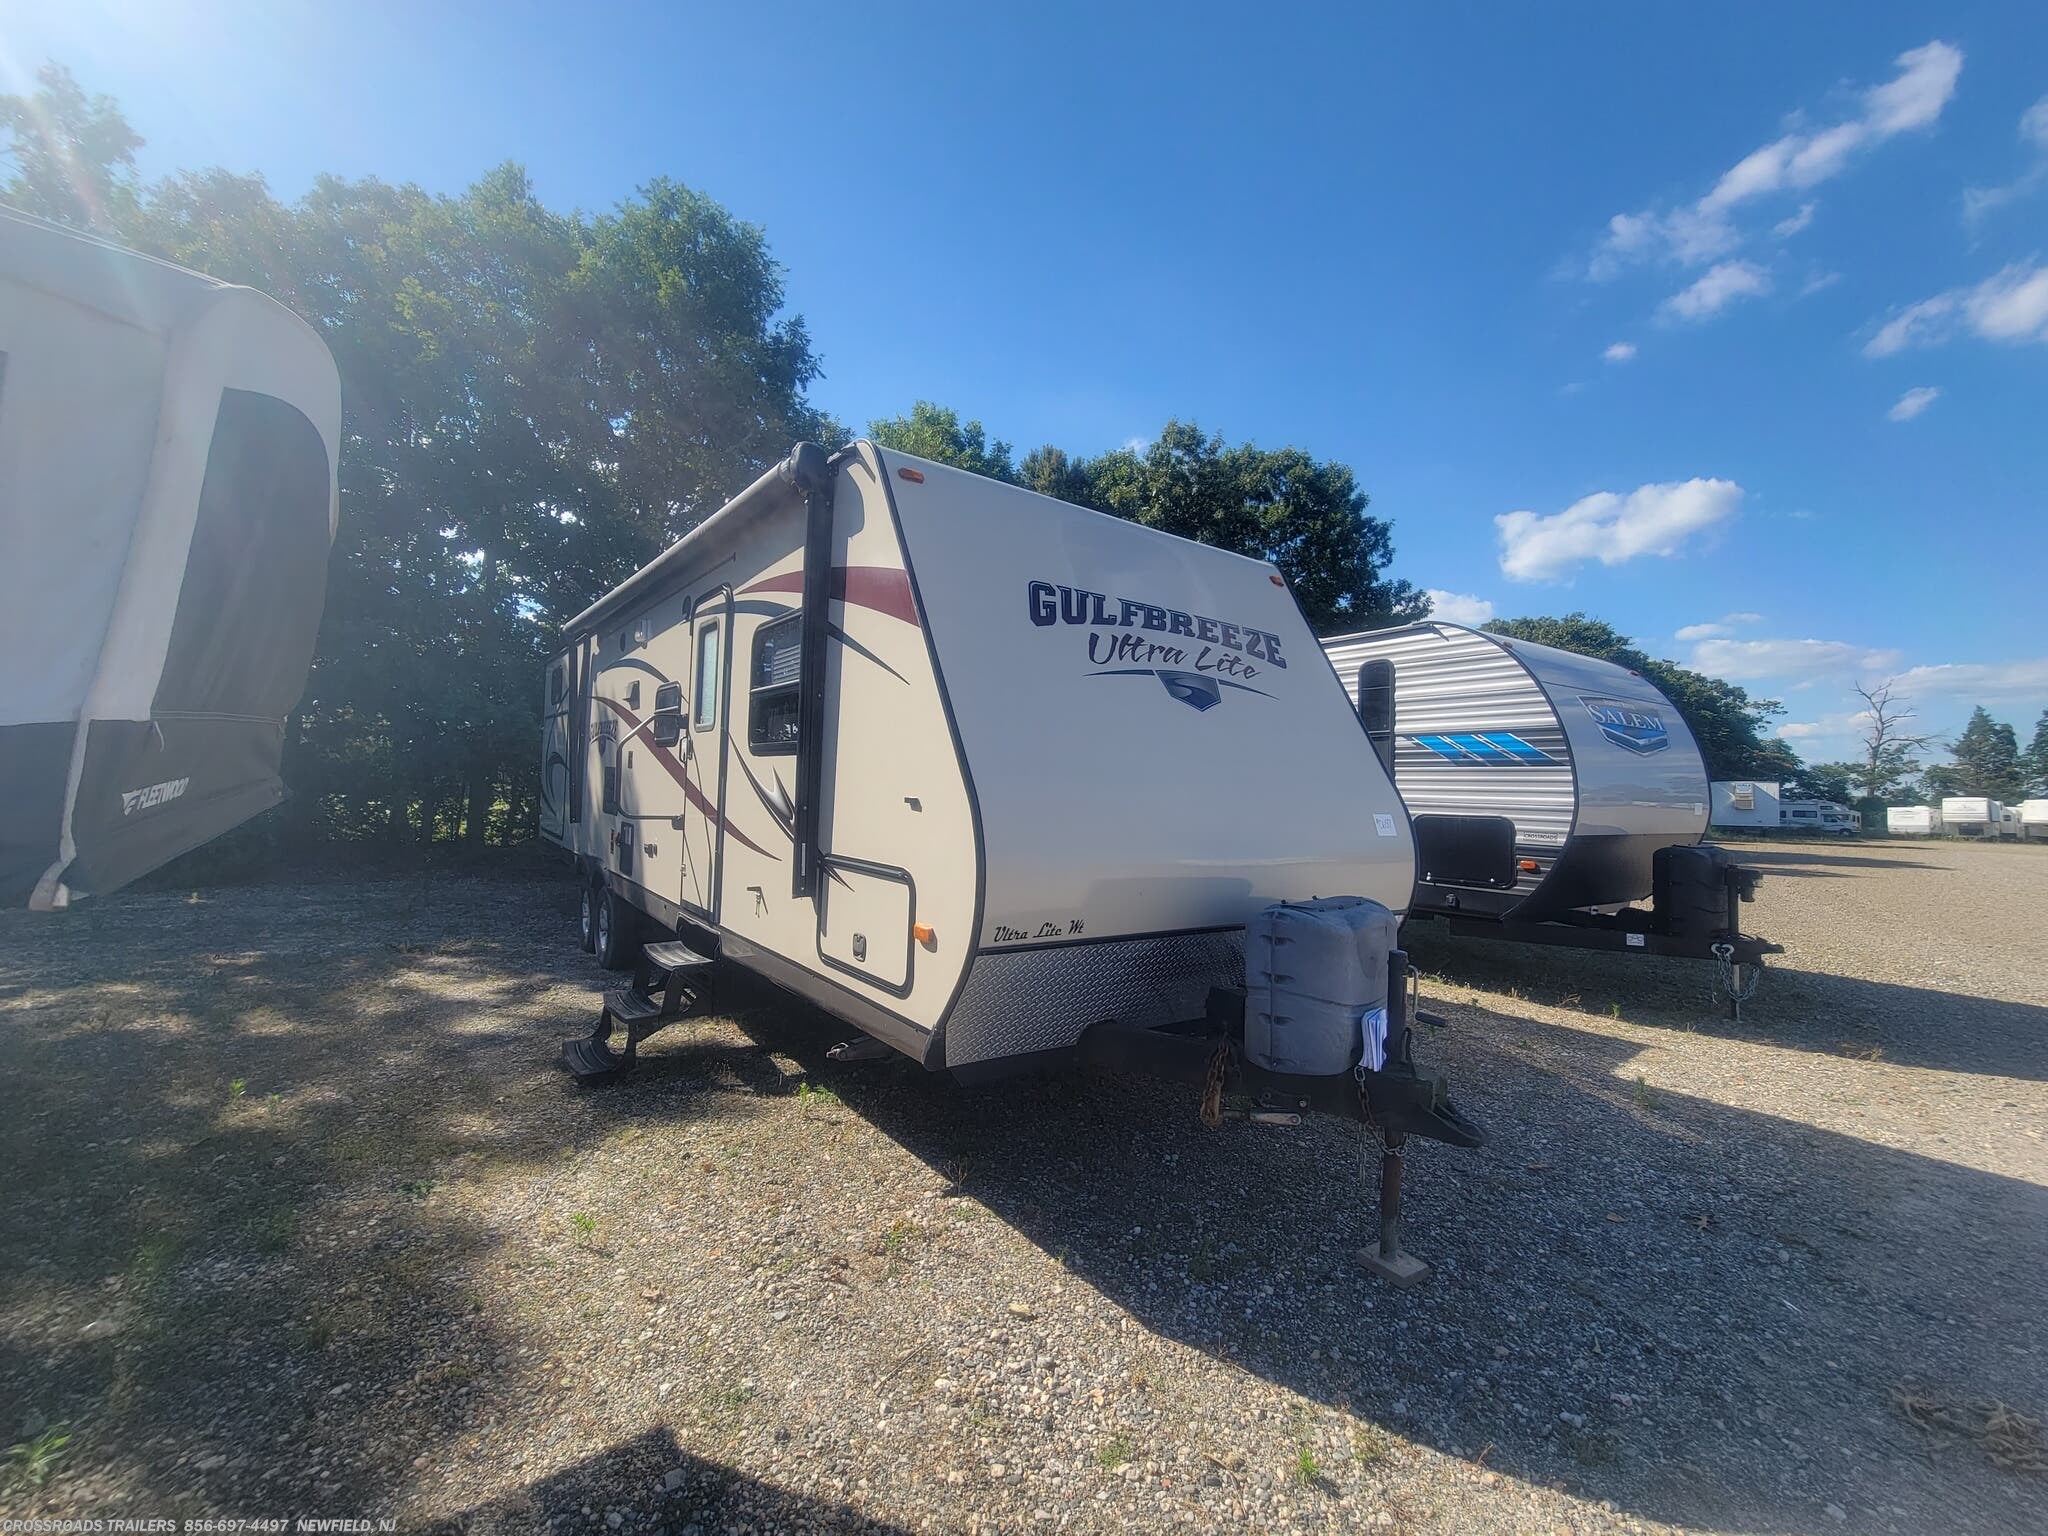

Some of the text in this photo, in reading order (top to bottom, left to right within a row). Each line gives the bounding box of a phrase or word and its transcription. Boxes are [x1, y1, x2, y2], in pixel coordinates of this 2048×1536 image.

[1028, 580, 1287, 669] GULFBREEZE
[1088, 632, 1261, 679] Ultra Lite
[1588, 704, 1665, 731] SALEM
[993, 926, 1028, 942] Ultra
[1032, 922, 1062, 938] Lite
